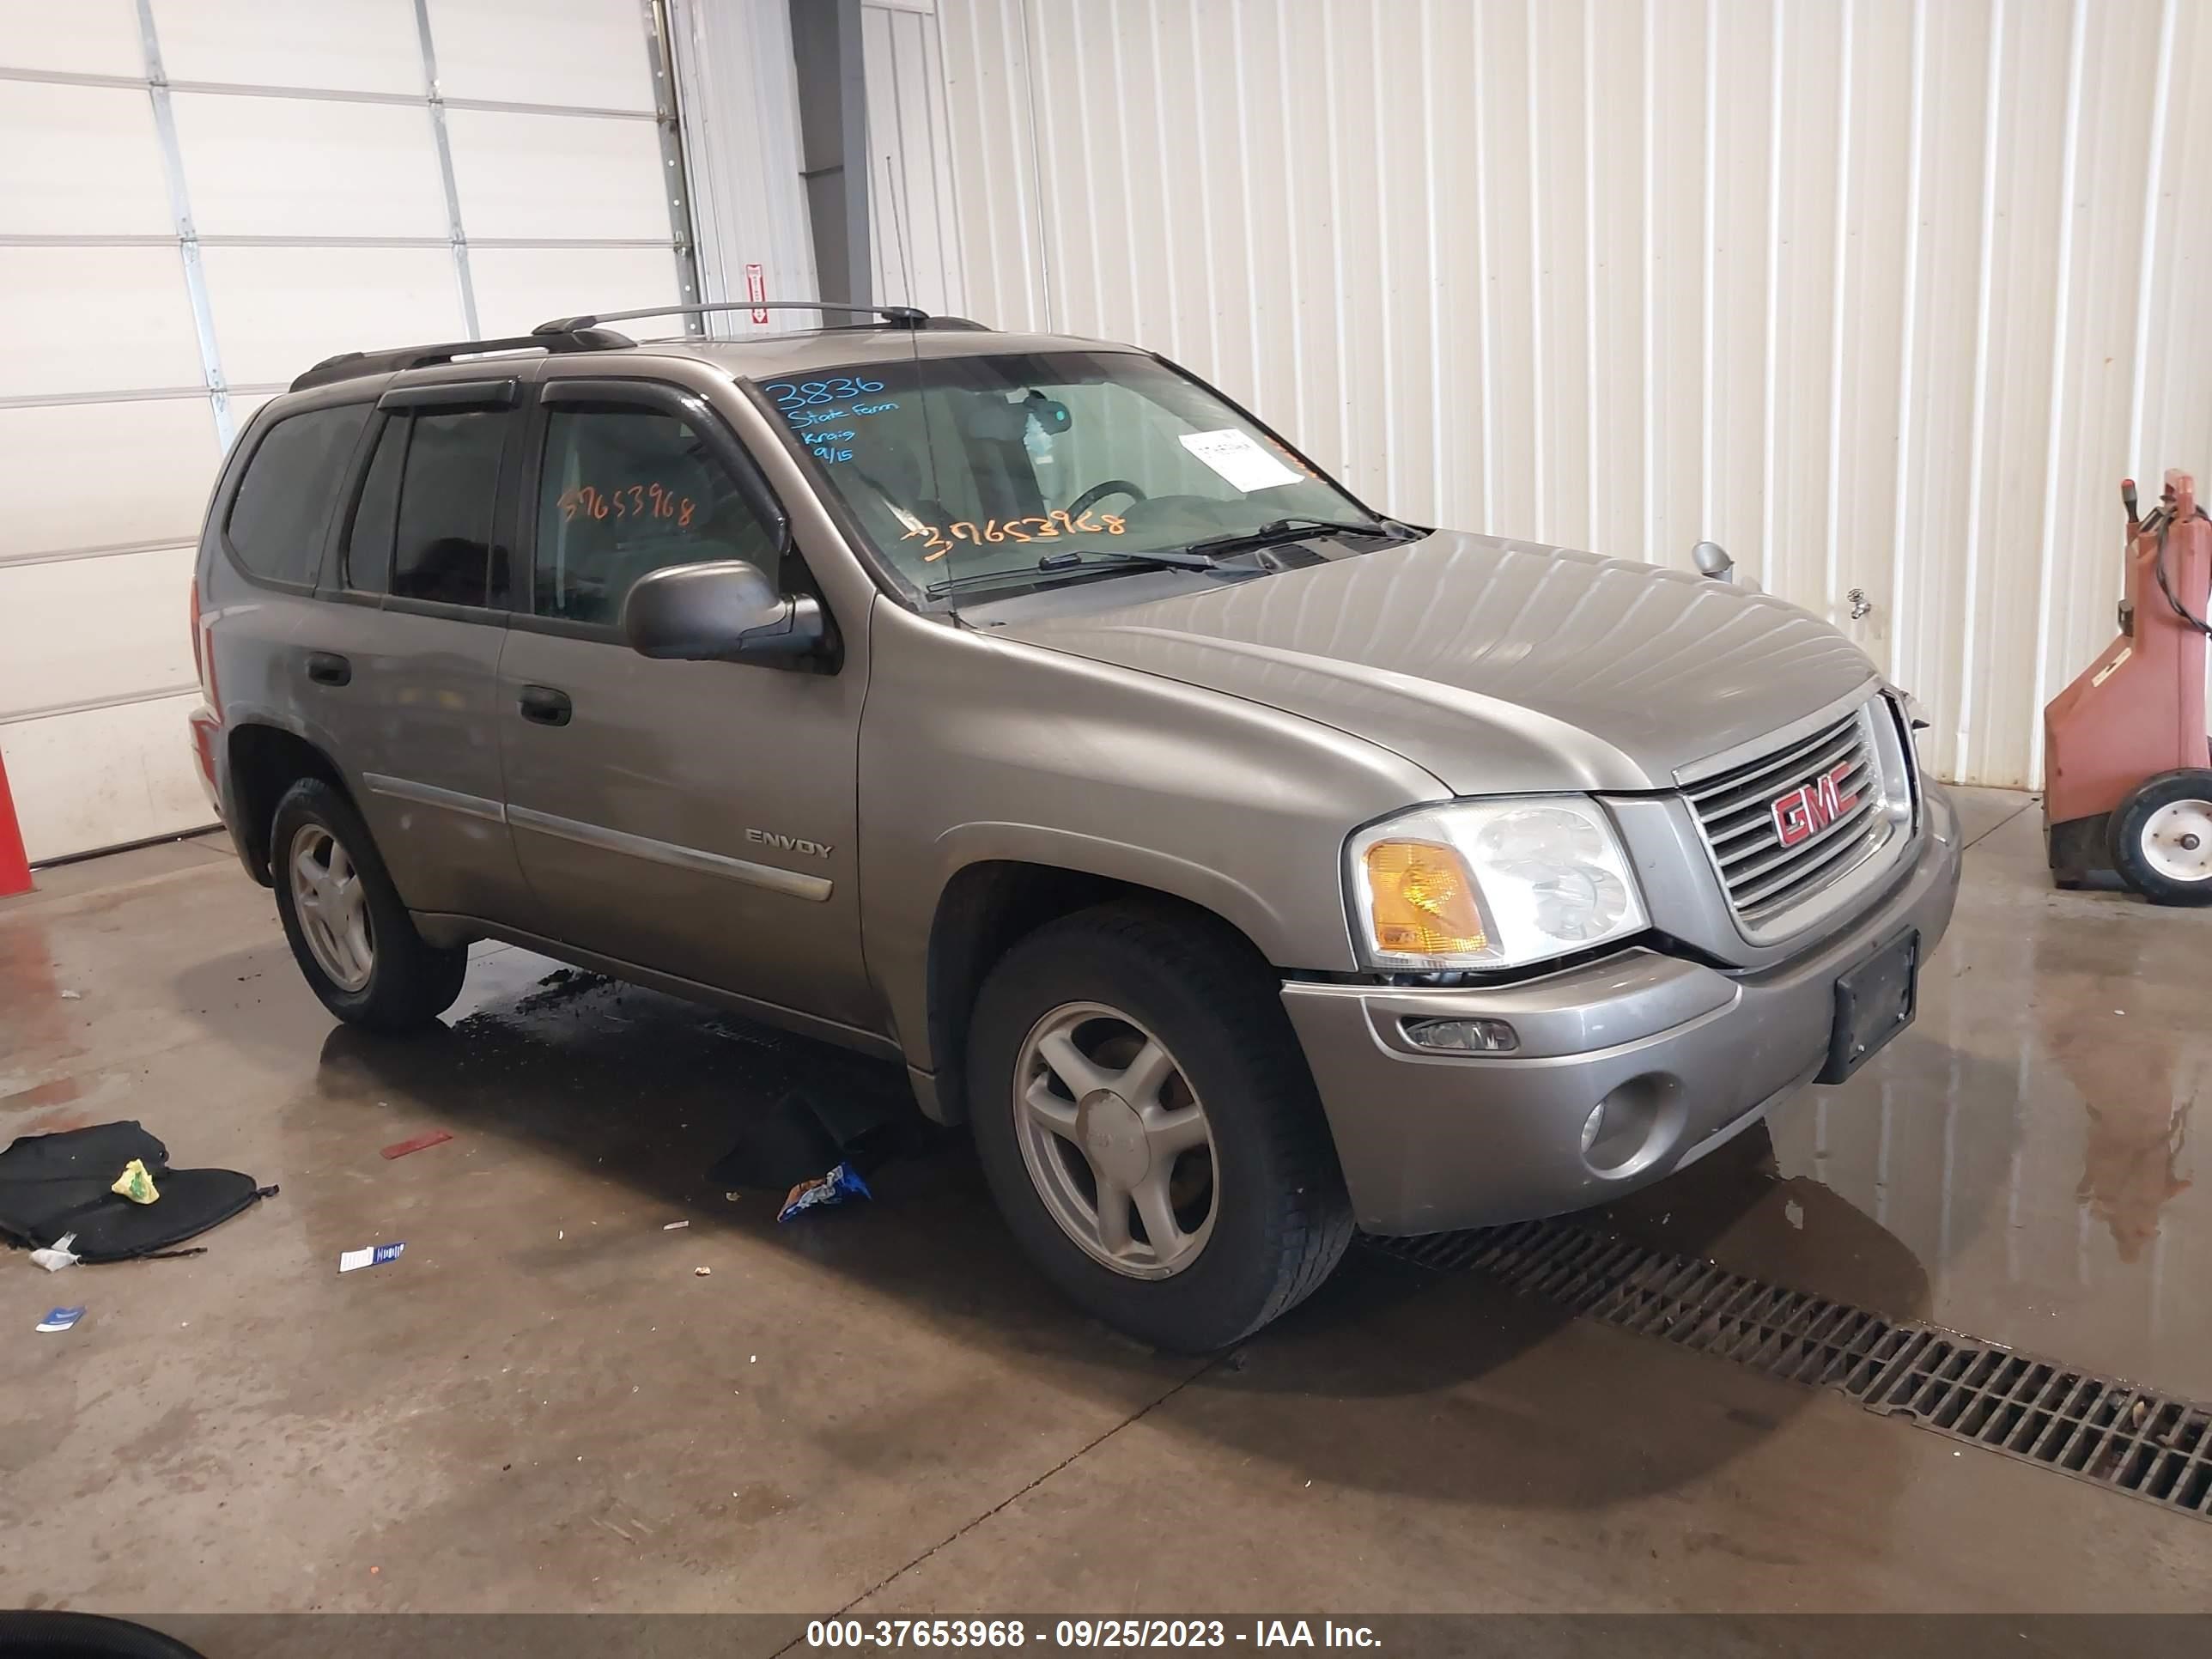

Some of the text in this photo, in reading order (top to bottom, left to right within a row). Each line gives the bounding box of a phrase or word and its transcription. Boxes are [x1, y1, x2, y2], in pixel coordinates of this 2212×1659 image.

[765, 377, 884, 410] 3836
[813, 447, 853, 464] 9/15
[557, 483, 696, 526] 37653968
[900, 510, 1126, 562] 37653968
[1771, 761, 1858, 848] GMC
[745, 828, 832, 859] ENVOY
